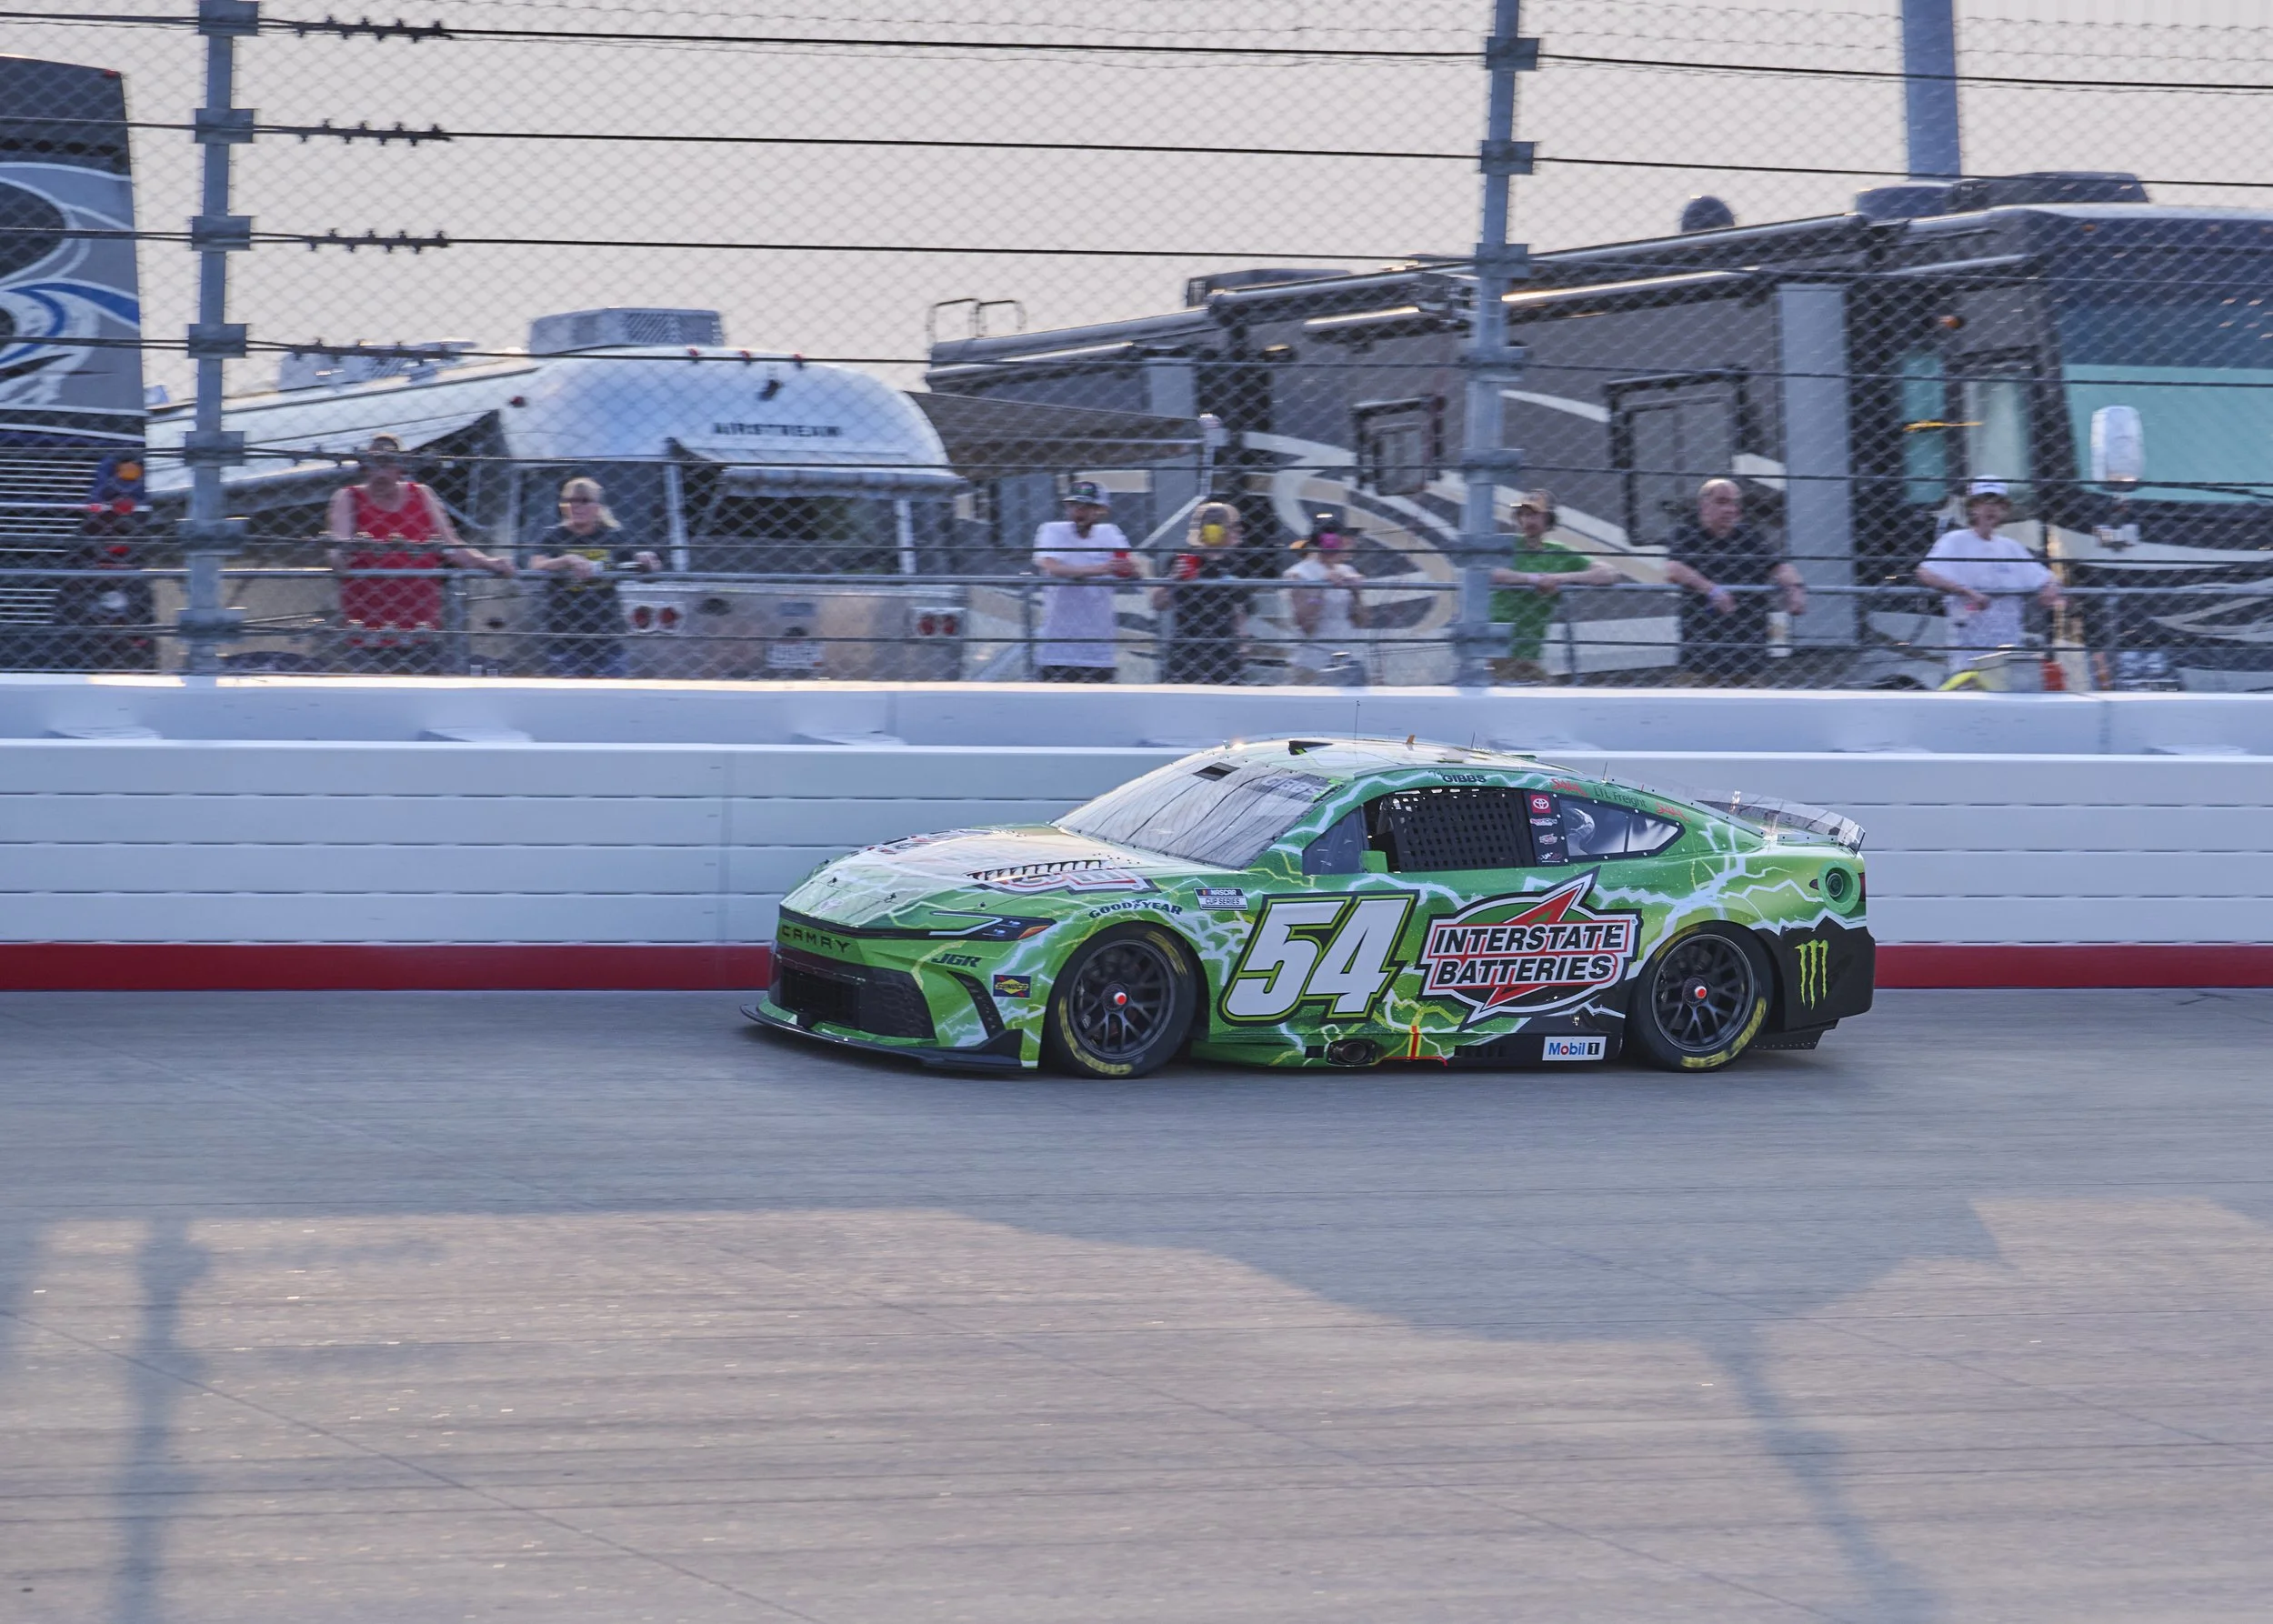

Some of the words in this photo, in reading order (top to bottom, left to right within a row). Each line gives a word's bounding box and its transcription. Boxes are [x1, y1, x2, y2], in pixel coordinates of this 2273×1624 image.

[1442, 774, 1487, 783] GIBBS
[1613, 791, 1647, 808] Freight
[1088, 898, 1182, 919] GOODYEAR
[1205, 897, 1218, 906] CUP
[1219, 897, 1240, 906] SERIES
[781, 924, 851, 954] CAMRY
[1433, 924, 1625, 954] INTERSTATE
[931, 953, 983, 967] JGR
[1222, 893, 1415, 1022] 54
[1436, 954, 1615, 986] BATTERIES
[1548, 1042, 1586, 1056] Mobil
